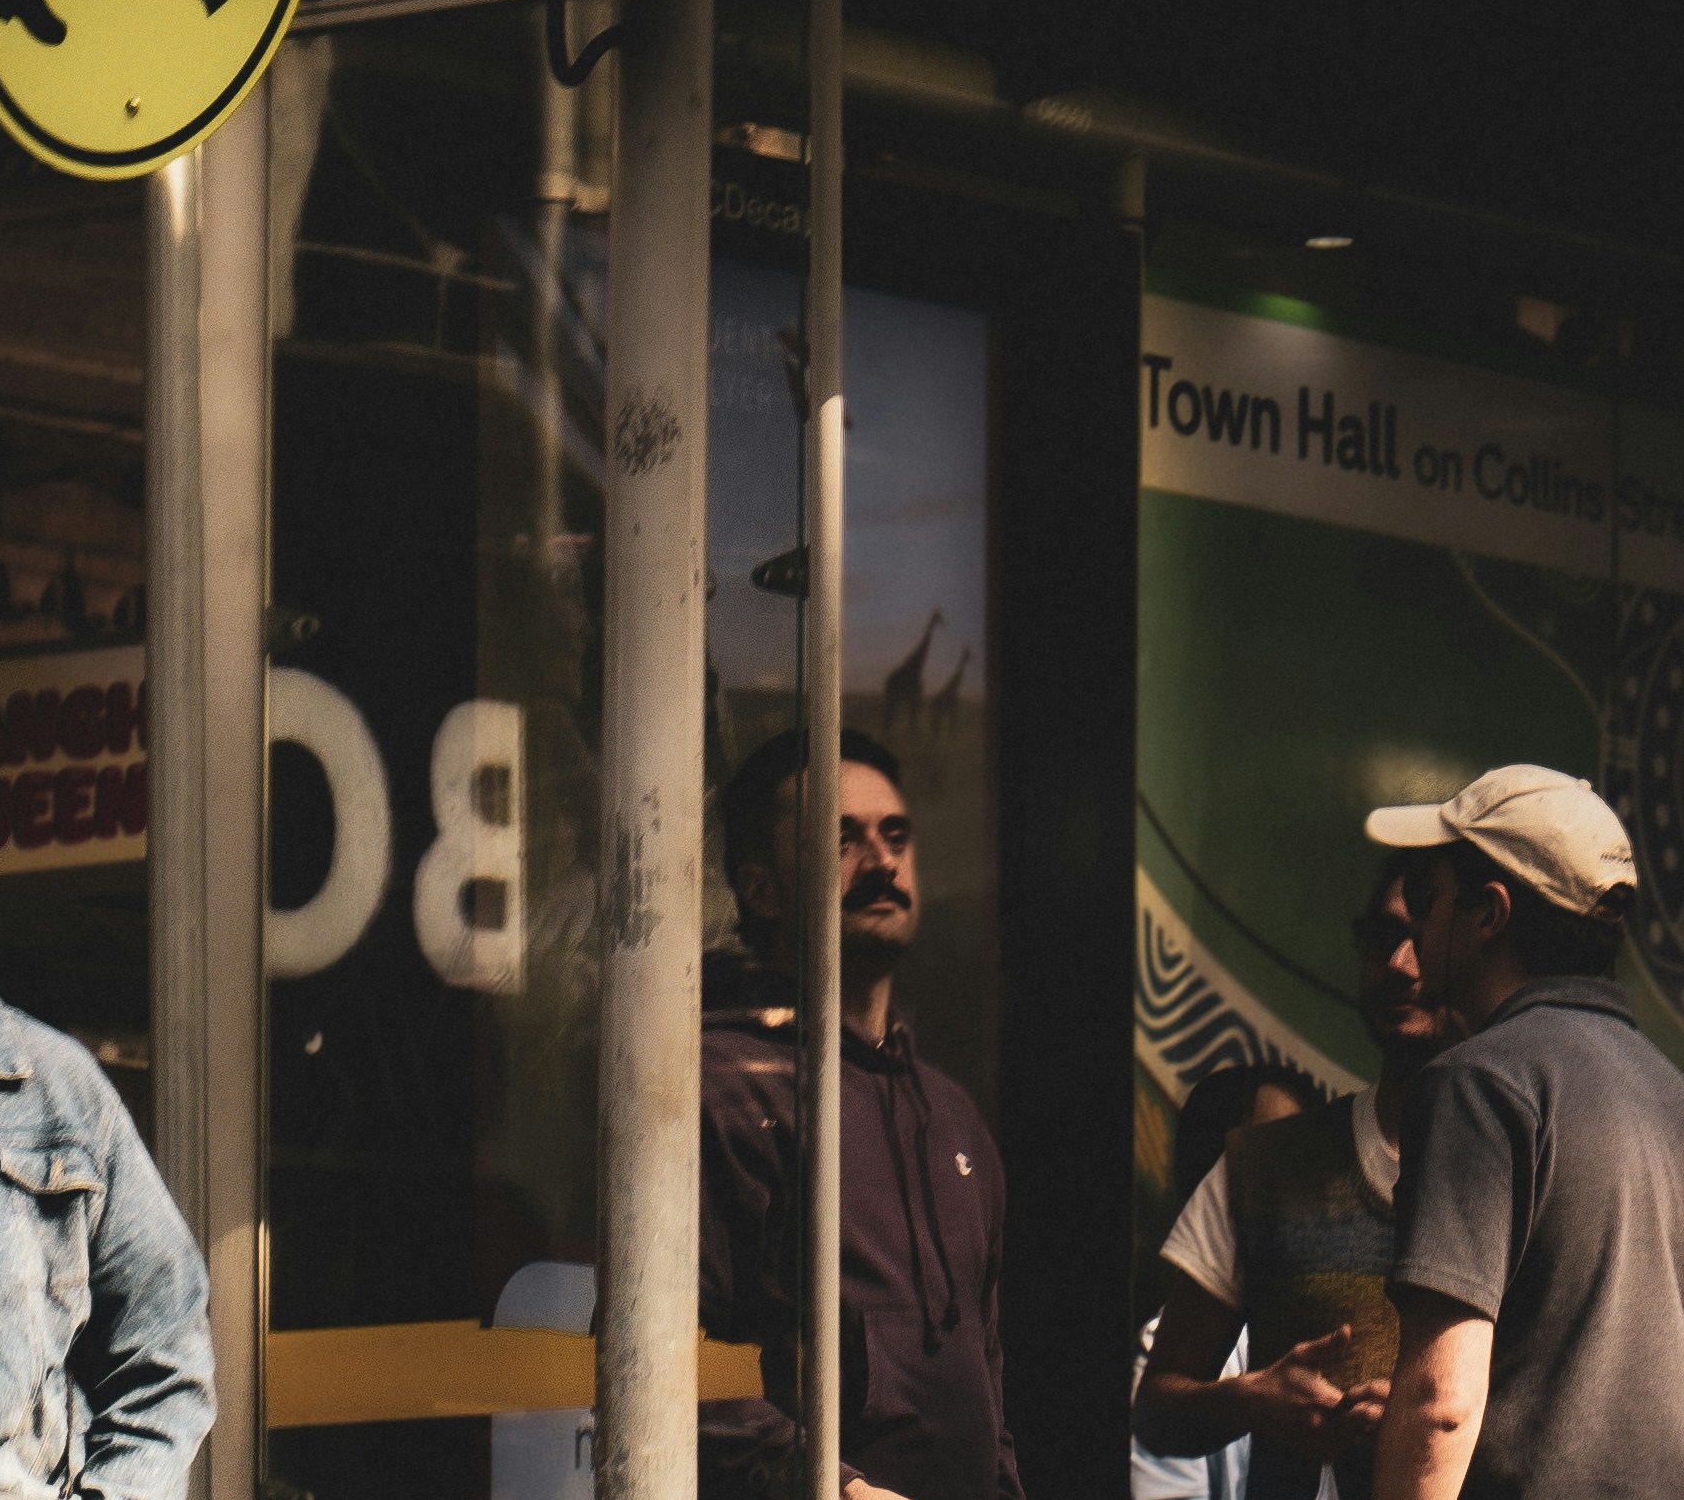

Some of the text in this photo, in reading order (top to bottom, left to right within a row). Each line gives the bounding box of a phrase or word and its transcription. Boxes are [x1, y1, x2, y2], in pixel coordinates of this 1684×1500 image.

[1143, 353, 1282, 454] Town
[1298, 386, 1401, 480] Hall
[1413, 443, 1465, 494] on
[1473, 442, 1608, 524] Collins
